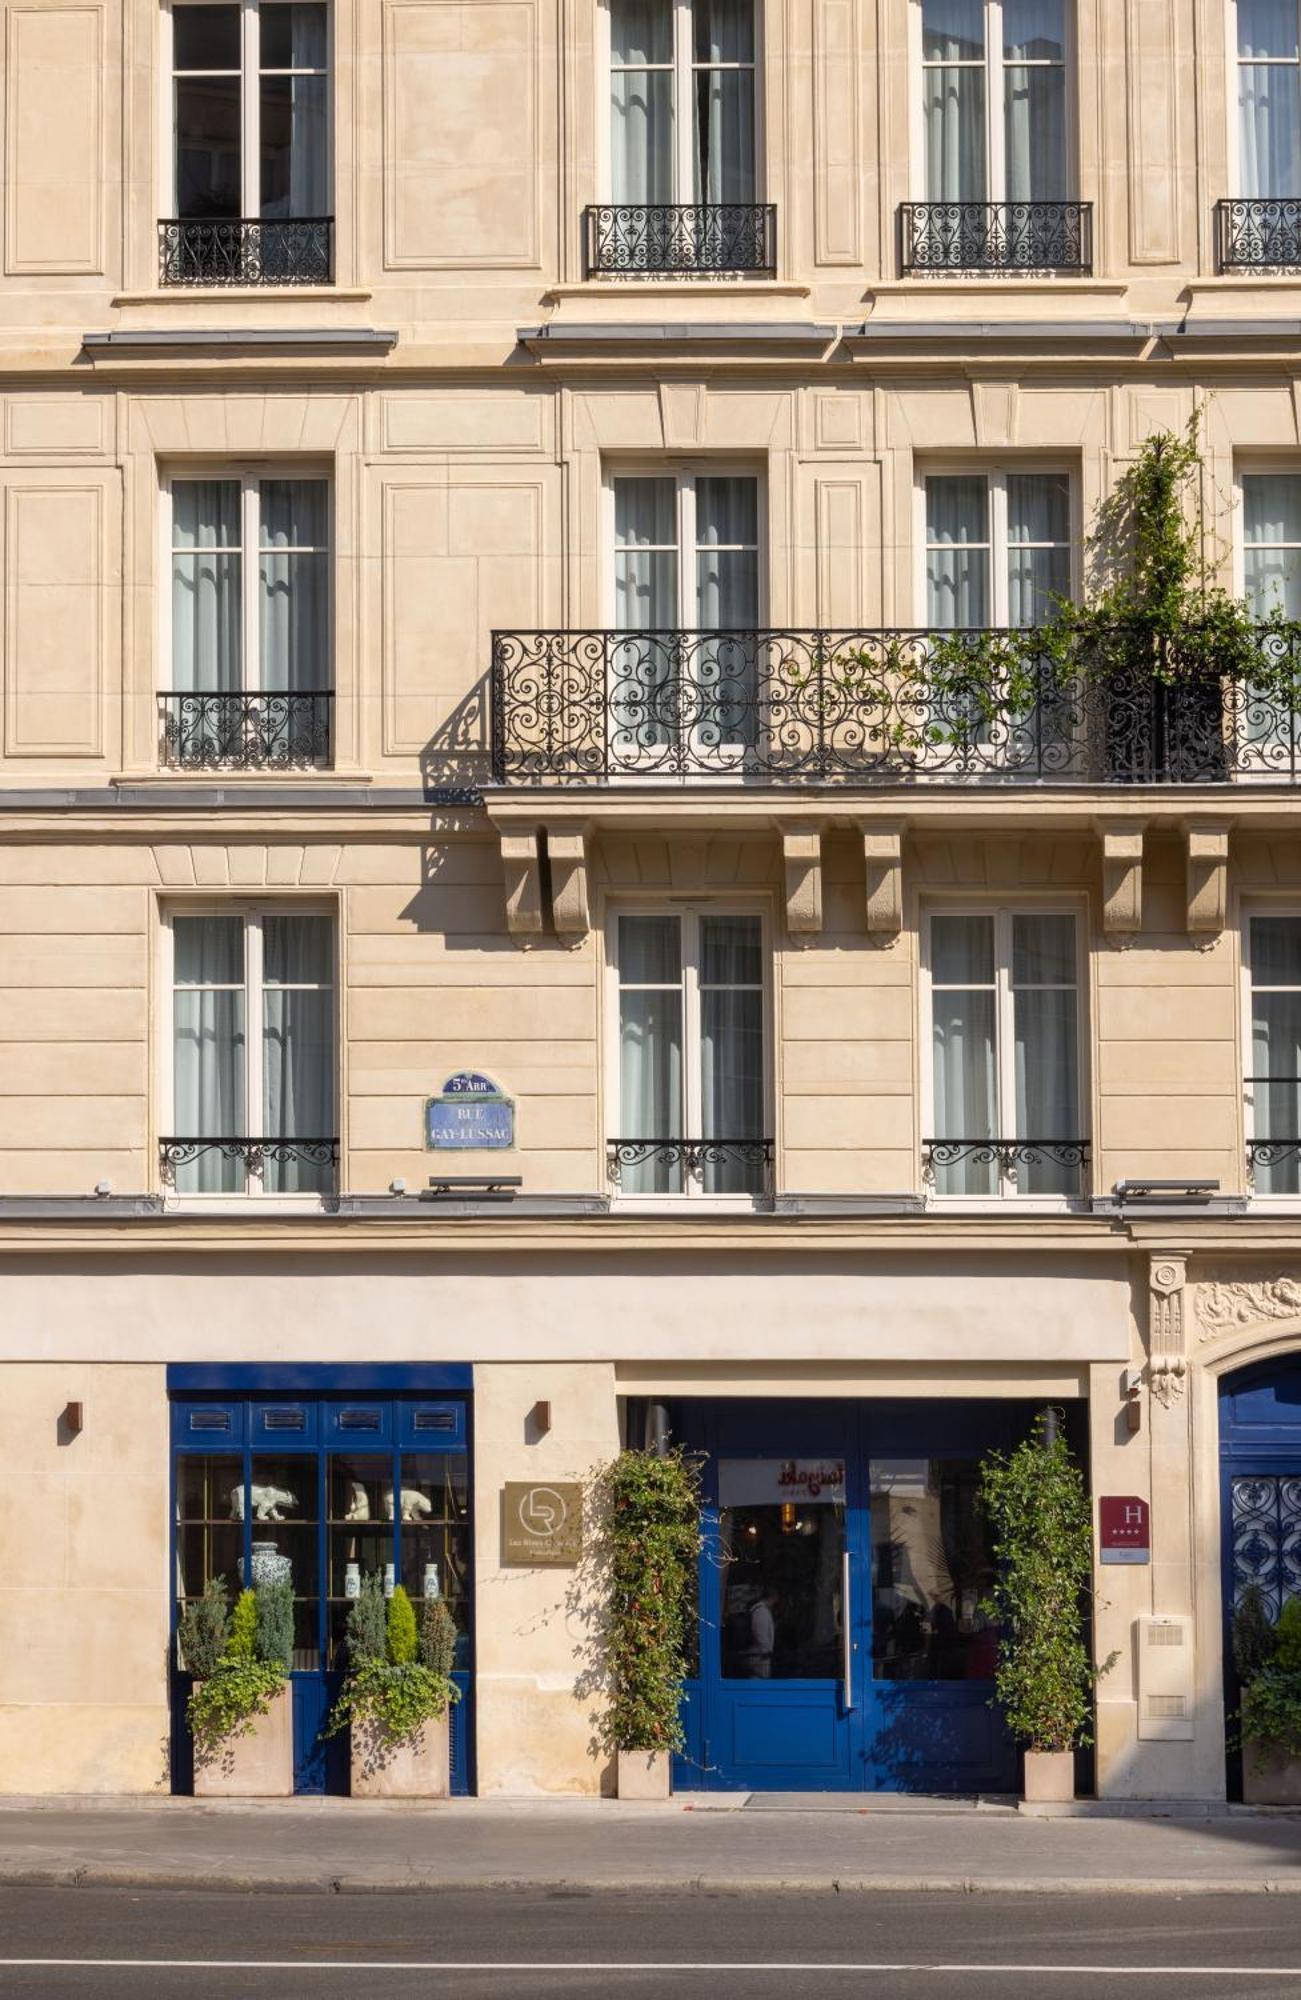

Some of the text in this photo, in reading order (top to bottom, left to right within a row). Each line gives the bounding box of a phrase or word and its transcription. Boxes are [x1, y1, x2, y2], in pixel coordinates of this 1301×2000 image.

[457, 1108, 485, 1120] RUE
[431, 1128, 509, 1140] GAY-LUSSAC
[1125, 1505, 1142, 1524] H
